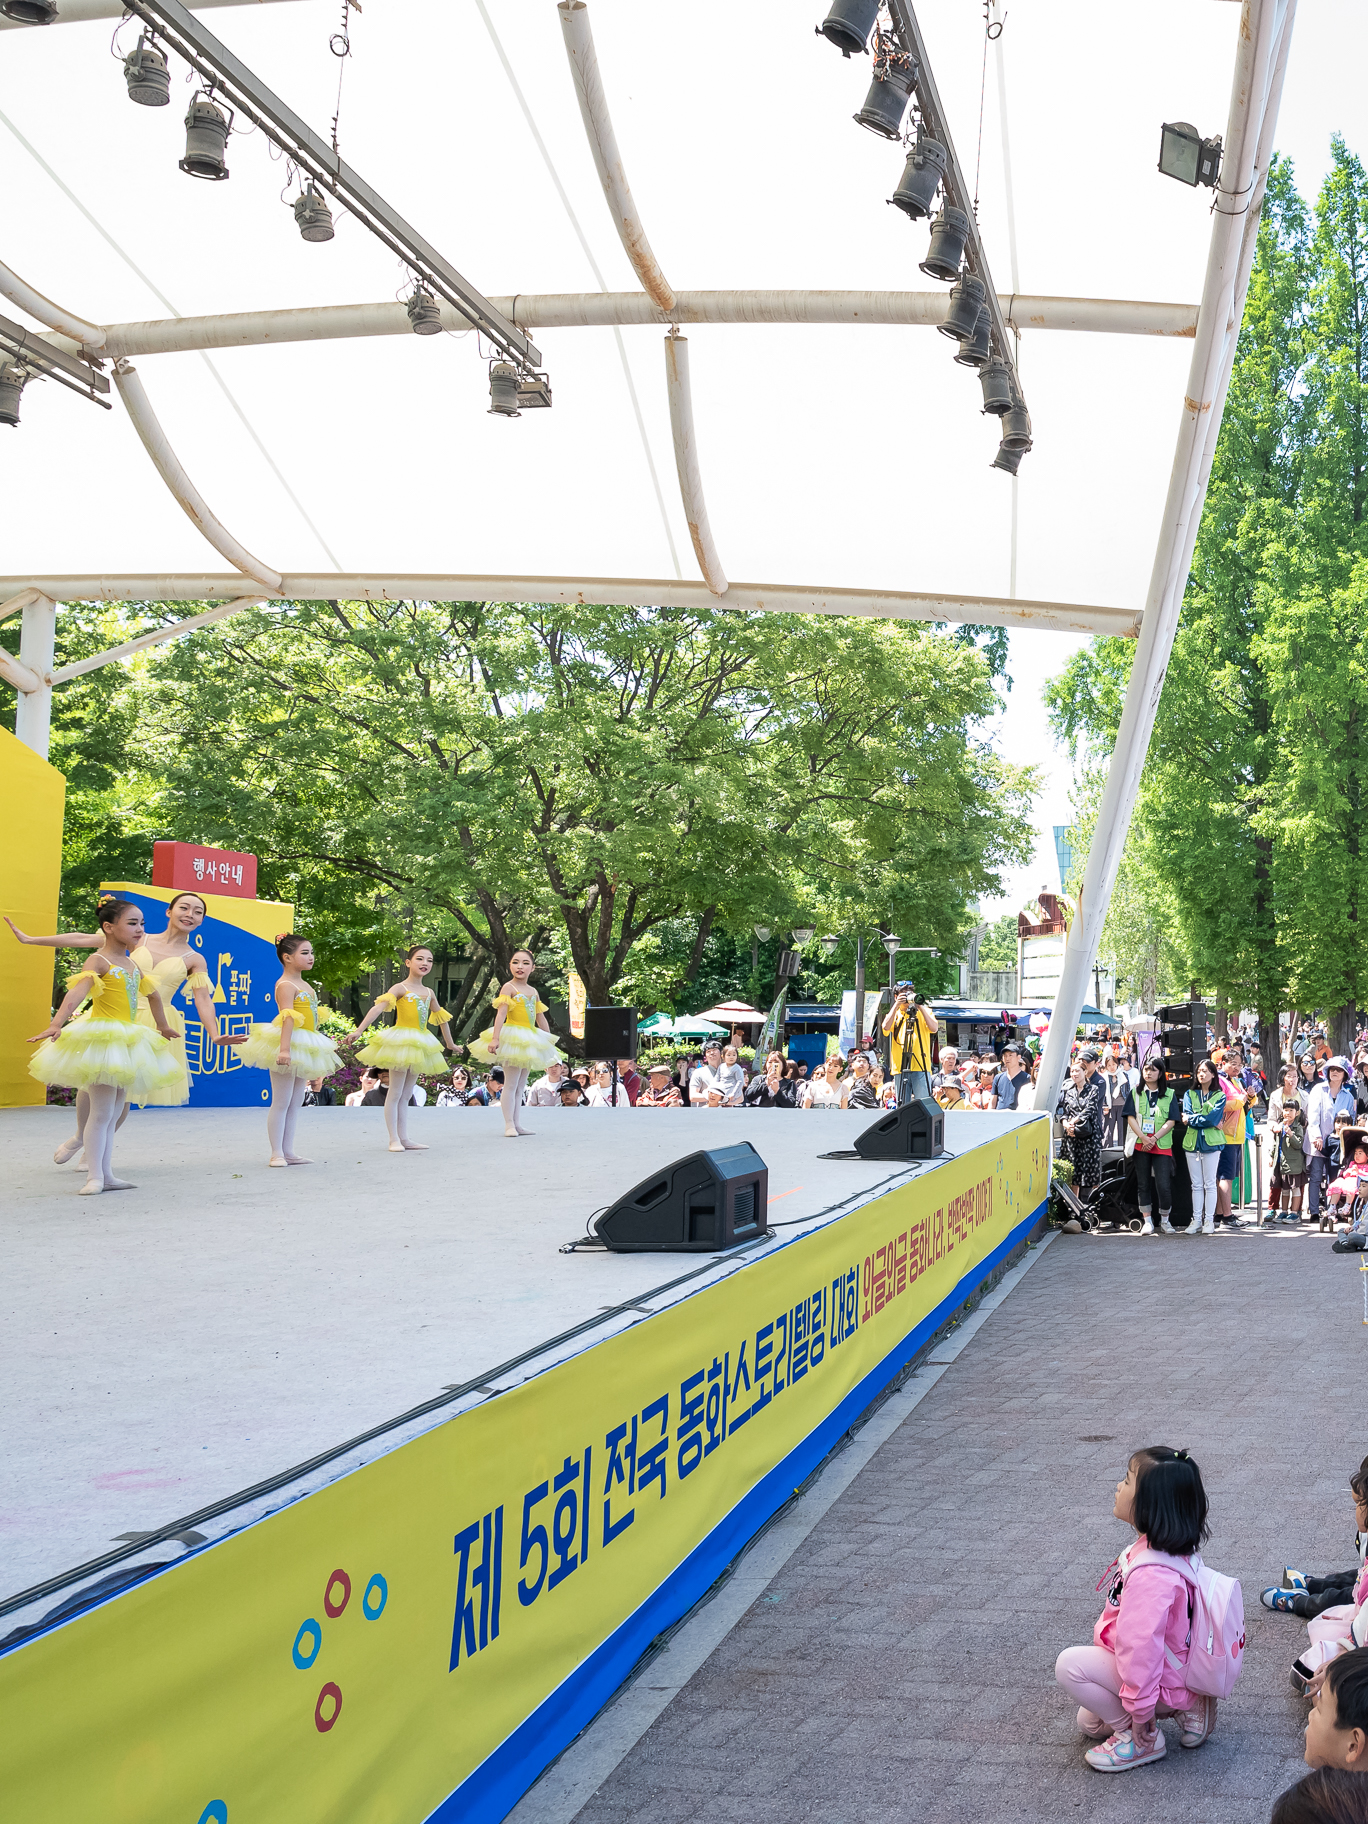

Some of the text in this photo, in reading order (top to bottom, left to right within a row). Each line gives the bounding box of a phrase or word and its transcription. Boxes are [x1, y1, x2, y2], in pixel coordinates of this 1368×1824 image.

[193, 857, 243, 886] 행사안내
[449, 1505, 503, 1673] 제
[518, 1445, 592, 1607] 5회
[602, 1393, 670, 1548] 전국
[677, 1286, 827, 1480] 동화스토리텔링
[830, 1264, 860, 1349] 대회
[909, 1207, 946, 1284] 동화나라,
[948, 1187, 974, 1253] 반짝반짝
[976, 1176, 993, 1227] 이야기
